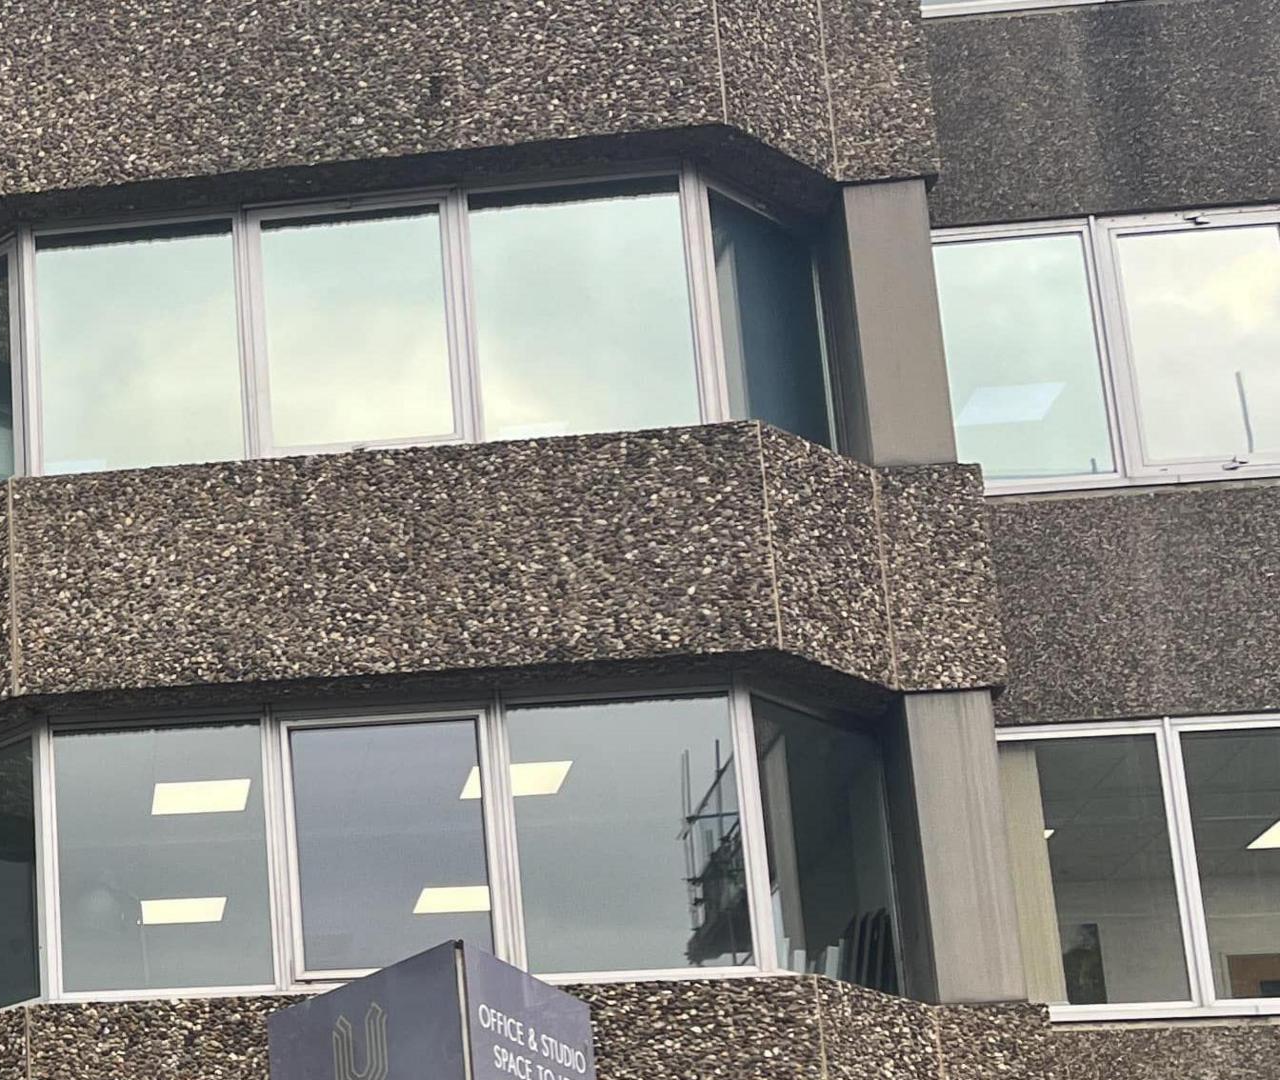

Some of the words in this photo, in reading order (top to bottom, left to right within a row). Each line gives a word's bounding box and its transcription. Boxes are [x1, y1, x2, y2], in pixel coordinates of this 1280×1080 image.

[478, 1003, 524, 1046] OFFICE
[527, 1027, 539, 1053] &
[540, 1033, 586, 1074] STUDIO
